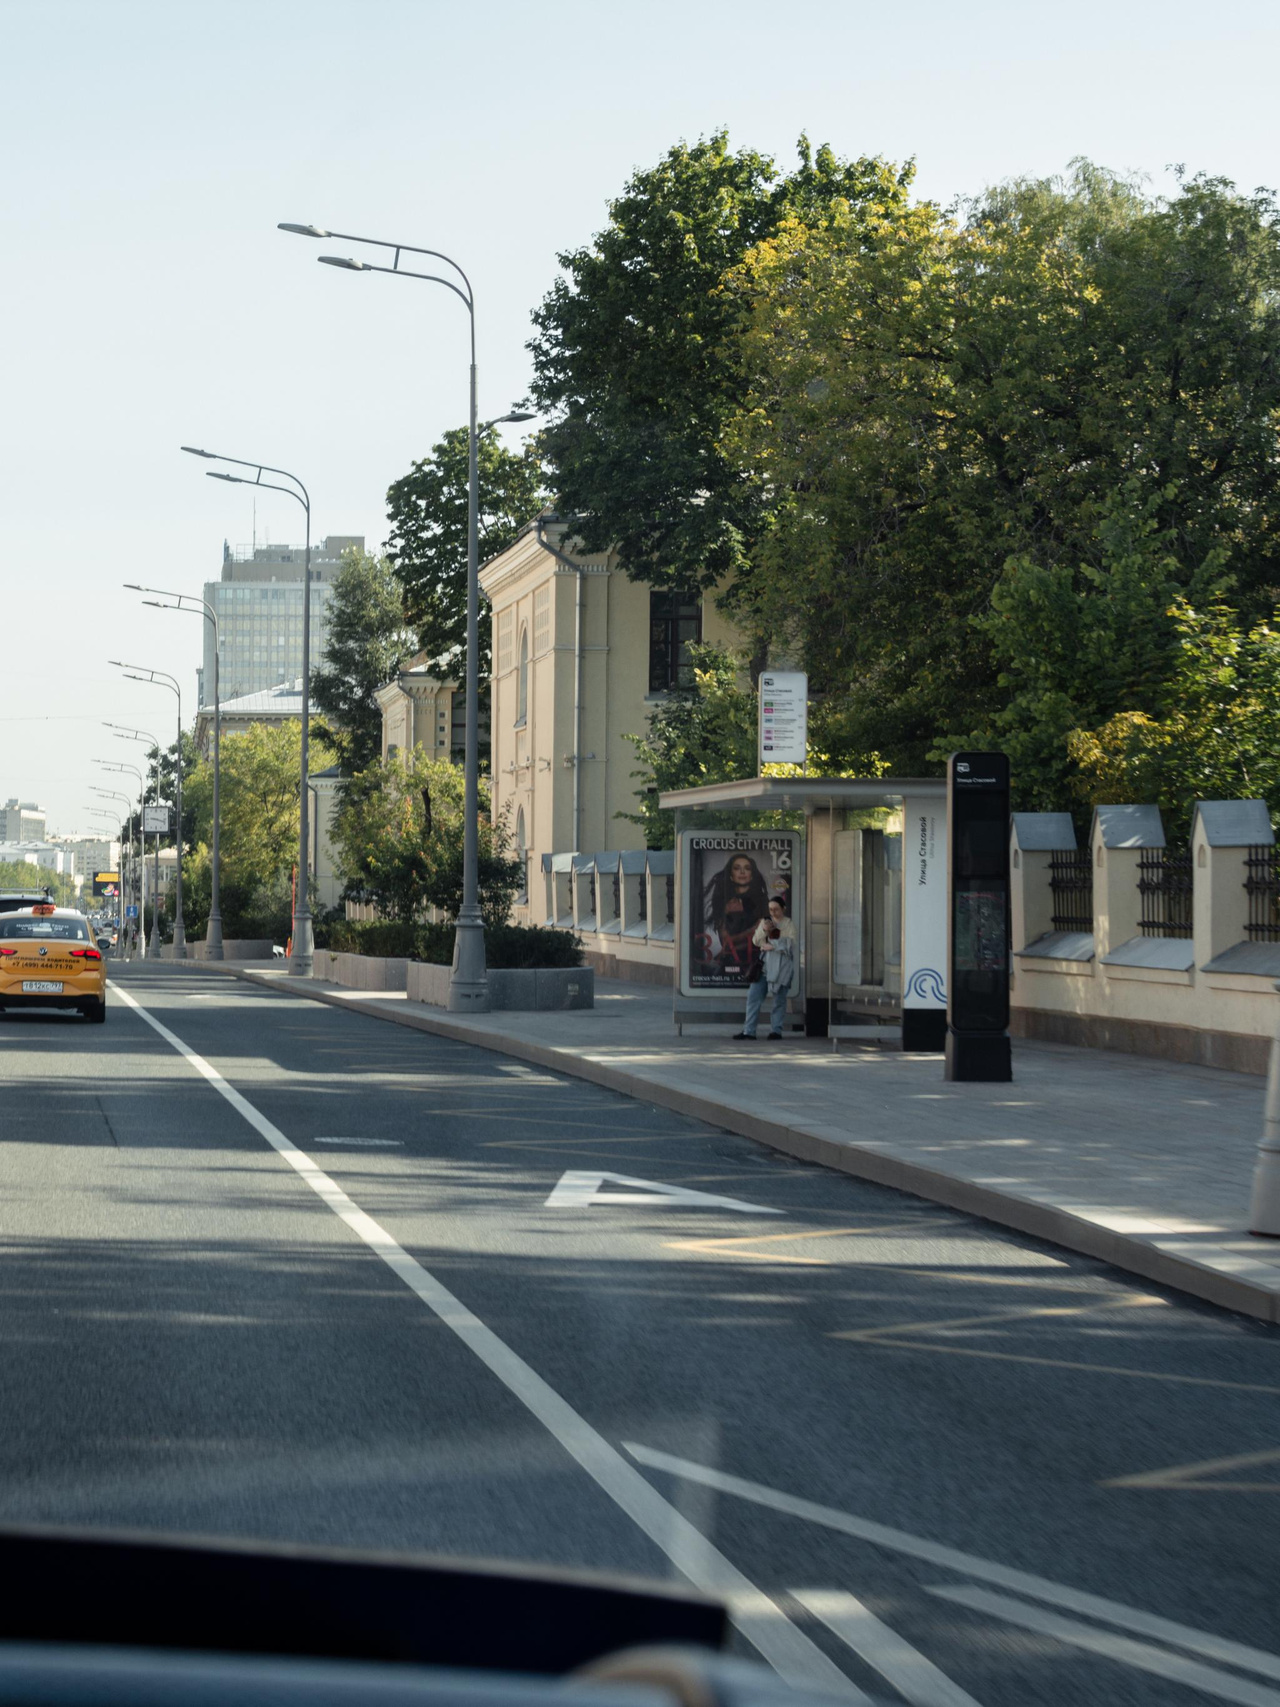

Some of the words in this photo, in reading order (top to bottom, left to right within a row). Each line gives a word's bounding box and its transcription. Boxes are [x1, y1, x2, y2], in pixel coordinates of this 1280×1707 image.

[693, 839, 735, 850] CROCUS
[737, 839, 761, 850] CITY
[762, 839, 791, 850] HALL
[919, 816, 927, 857] Стасовой
[770, 851, 791, 869] 16
[918, 859, 927, 886] Улица
